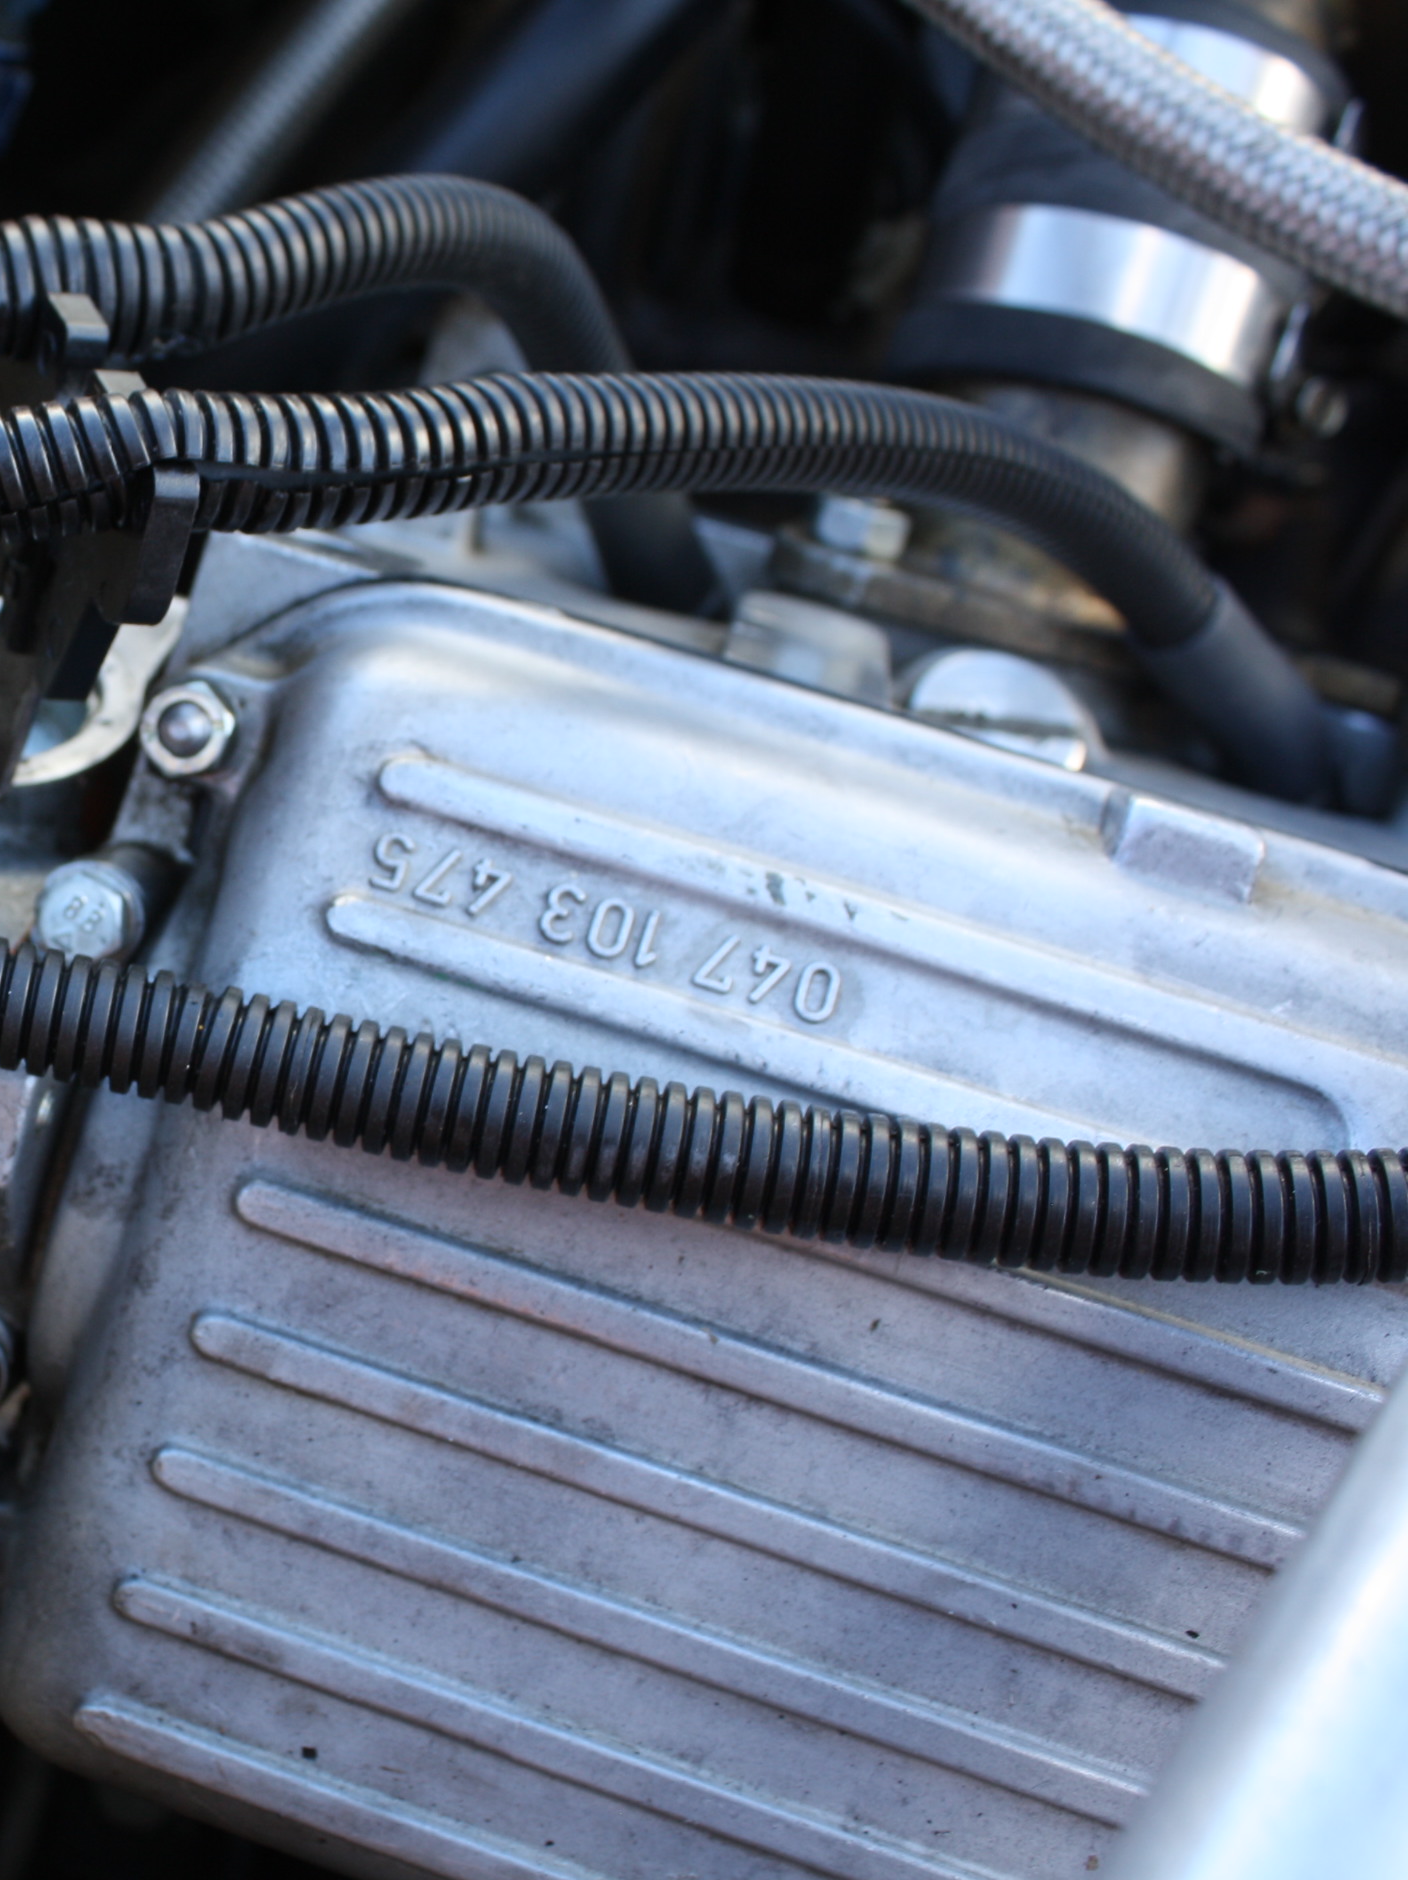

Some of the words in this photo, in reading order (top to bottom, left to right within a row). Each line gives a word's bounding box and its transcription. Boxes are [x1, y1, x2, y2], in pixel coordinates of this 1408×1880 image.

[369, 832, 512, 917] 475
[540, 883, 660, 968] 103
[692, 934, 842, 1022] 047
